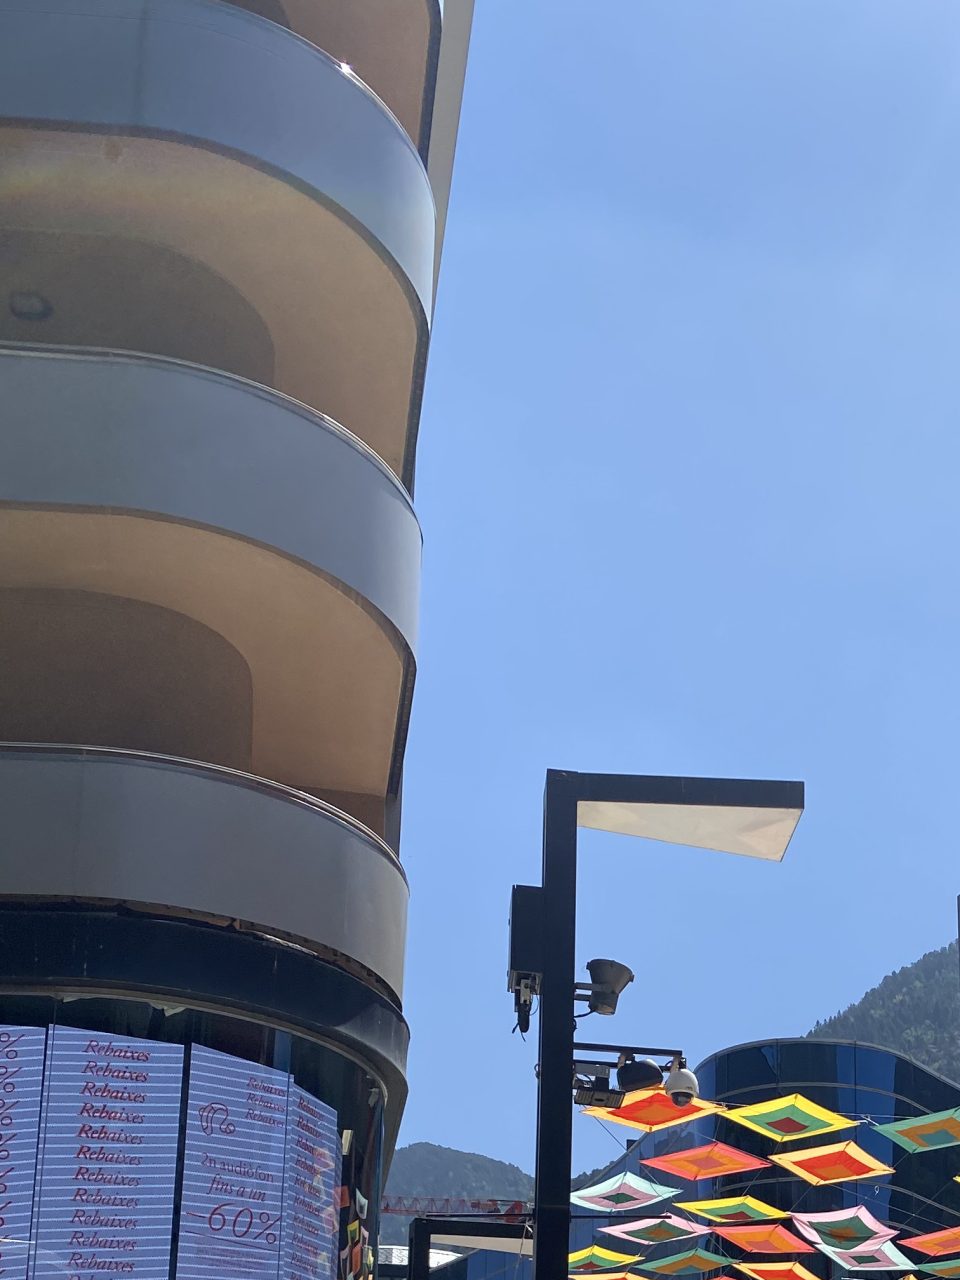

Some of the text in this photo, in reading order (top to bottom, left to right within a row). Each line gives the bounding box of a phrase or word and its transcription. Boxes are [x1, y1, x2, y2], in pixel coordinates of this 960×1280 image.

[82, 1040, 150, 1062] Rebaixes
[81, 1060, 149, 1083] Rebaixes
[80, 1081, 147, 1104] Rebaixes
[78, 1102, 146, 1125] Rebaixes
[76, 1123, 144, 1145] Rebaixes
[74, 1144, 142, 1166] Rebaixes
[72, 1166, 141, 1187] Rebaixes
[206, 1173, 266, 1202] fins a un
[70, 1187, 140, 1209] Rebaixes
[69, 1208, 138, 1230] Rebaixes
[68, 1229, 137, 1252] Rebaixes
[66, 1251, 136, 1273] Rebaixes
